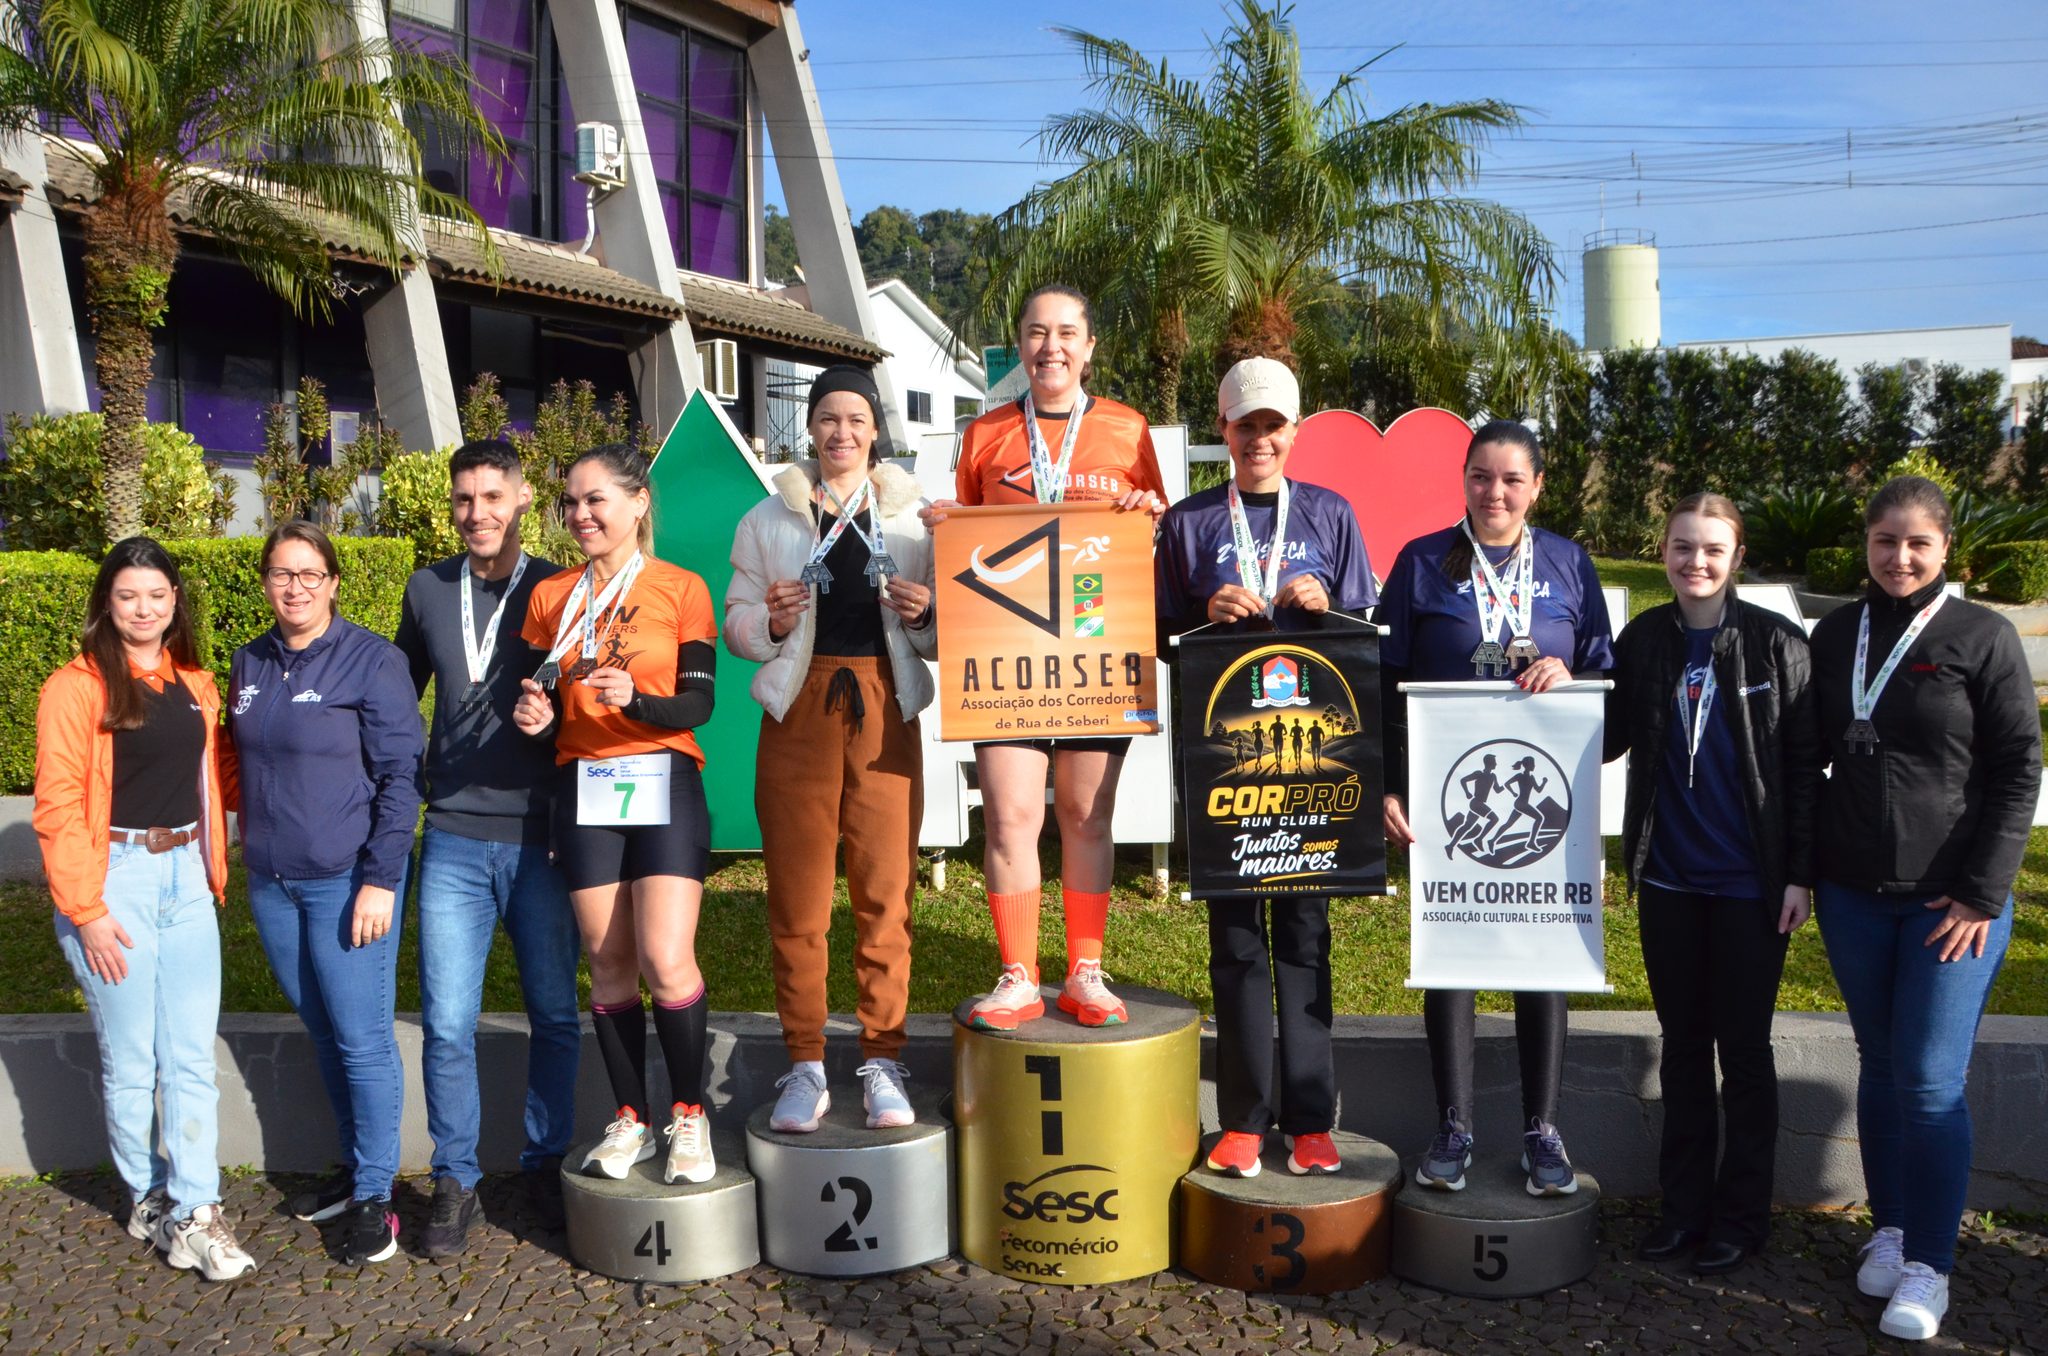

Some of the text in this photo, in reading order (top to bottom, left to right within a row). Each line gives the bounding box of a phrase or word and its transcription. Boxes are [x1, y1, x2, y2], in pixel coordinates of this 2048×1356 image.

[1064, 474, 1119, 493] ORSEB
[1235, 522, 1243, 548] CRESOL
[963, 652, 1141, 692] ACORSEB
[1747, 681, 1771, 693] Sicredi
[961, 692, 1142, 711] Associação dos Corredores
[995, 715, 1109, 729] de Rua de Seberi
[587, 766, 615, 777] Sesc
[614, 783, 636, 819] 7
[1241, 815, 1328, 828] RUN CLUBE
[1231, 829, 1339, 861] Juntos somos
[1238, 851, 1338, 877] maiores.
[1422, 881, 1592, 905] VEM CORRER RB
[1422, 910, 1593, 925] ASSOCIAÇÃO CULTURAL E ESPORTIVA
[1025, 1055, 1063, 1155] 1
[820, 1176, 878, 1253] 2
[1002, 1181, 1119, 1223] Sesc
[633, 1220, 672, 1266] 4
[1253, 1212, 1307, 1290] 3
[1002, 1255, 1062, 1278] Senac
[1472, 1234, 1509, 1282] 5
